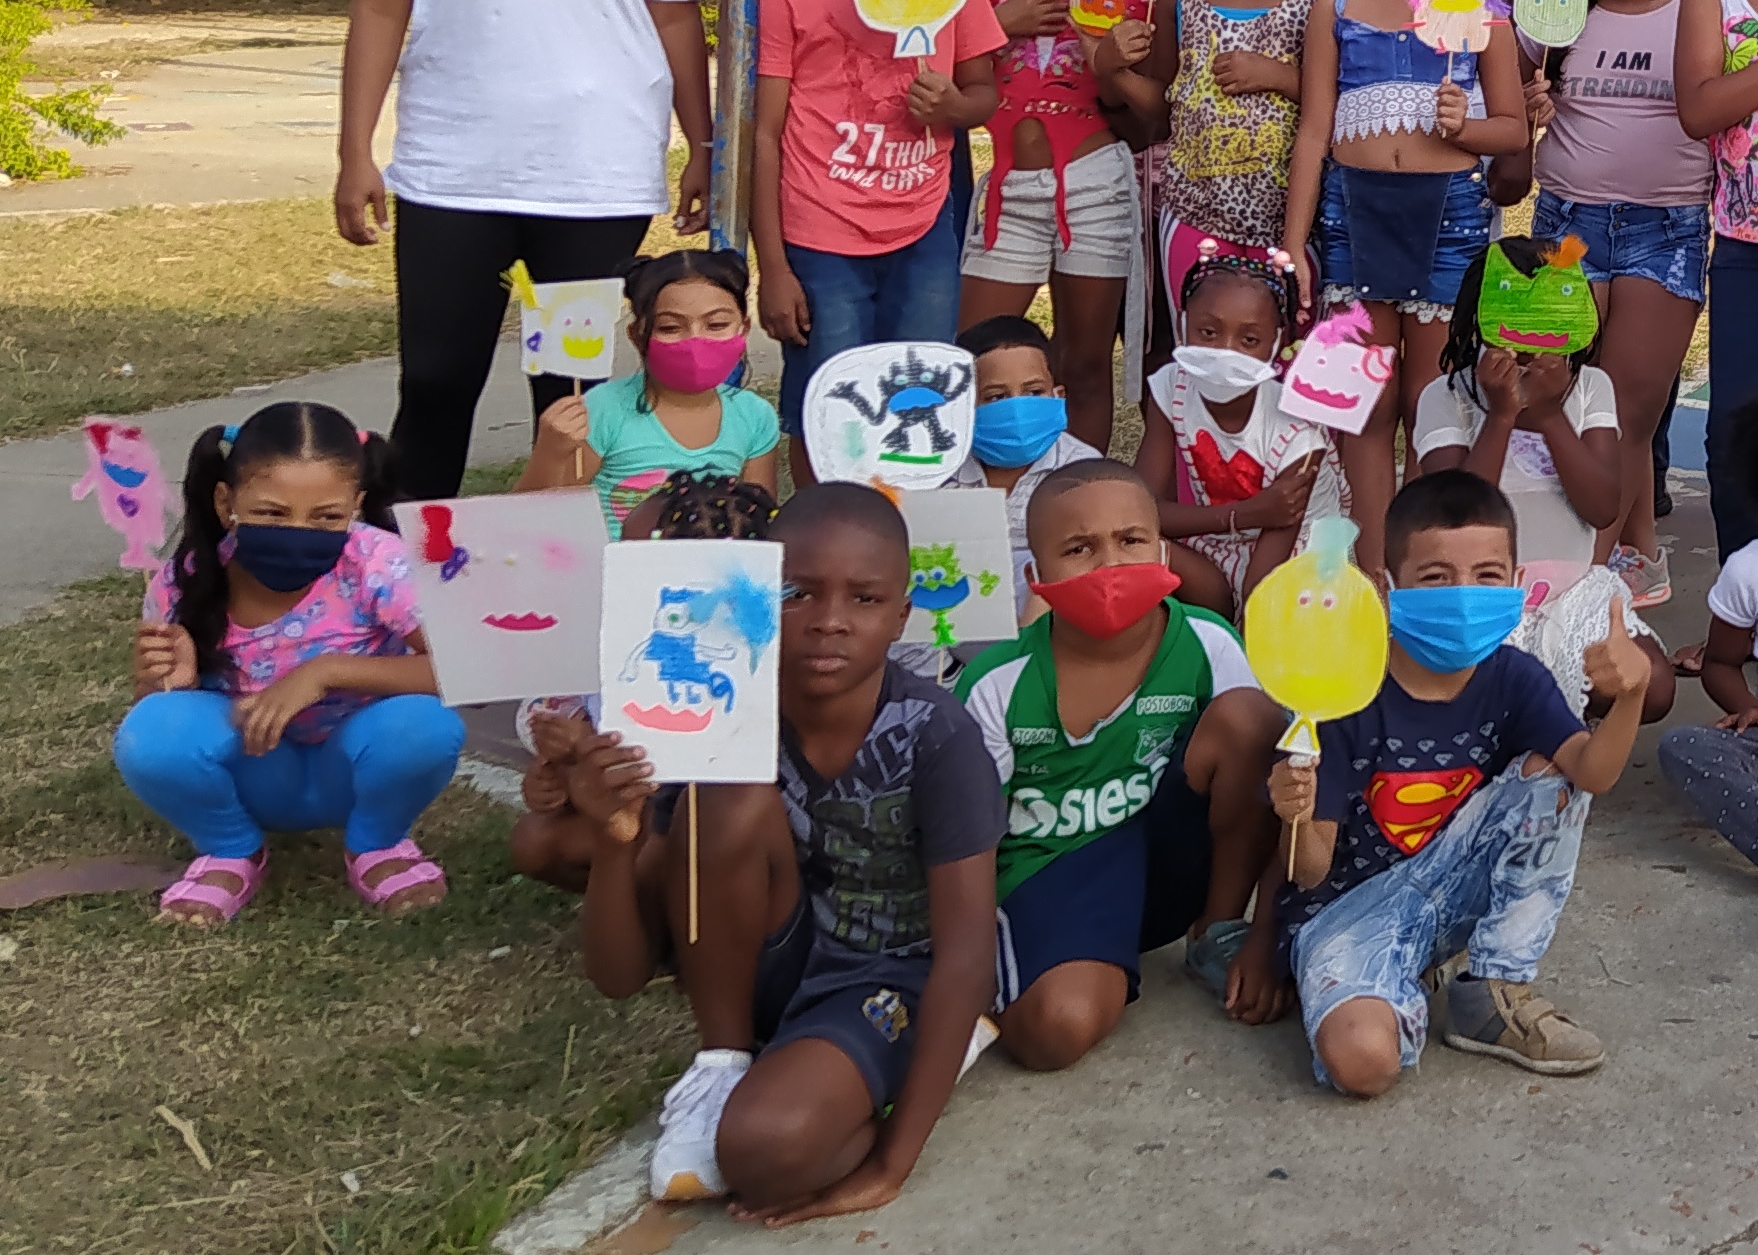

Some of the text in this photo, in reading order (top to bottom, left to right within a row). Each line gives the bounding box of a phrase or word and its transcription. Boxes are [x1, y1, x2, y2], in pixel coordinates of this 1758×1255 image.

[1595, 50, 1653, 71] I AM
[1568, 76, 1675, 102] TRENDIN
[831, 121, 886, 167] 27
[1506, 836, 1560, 868] 20
